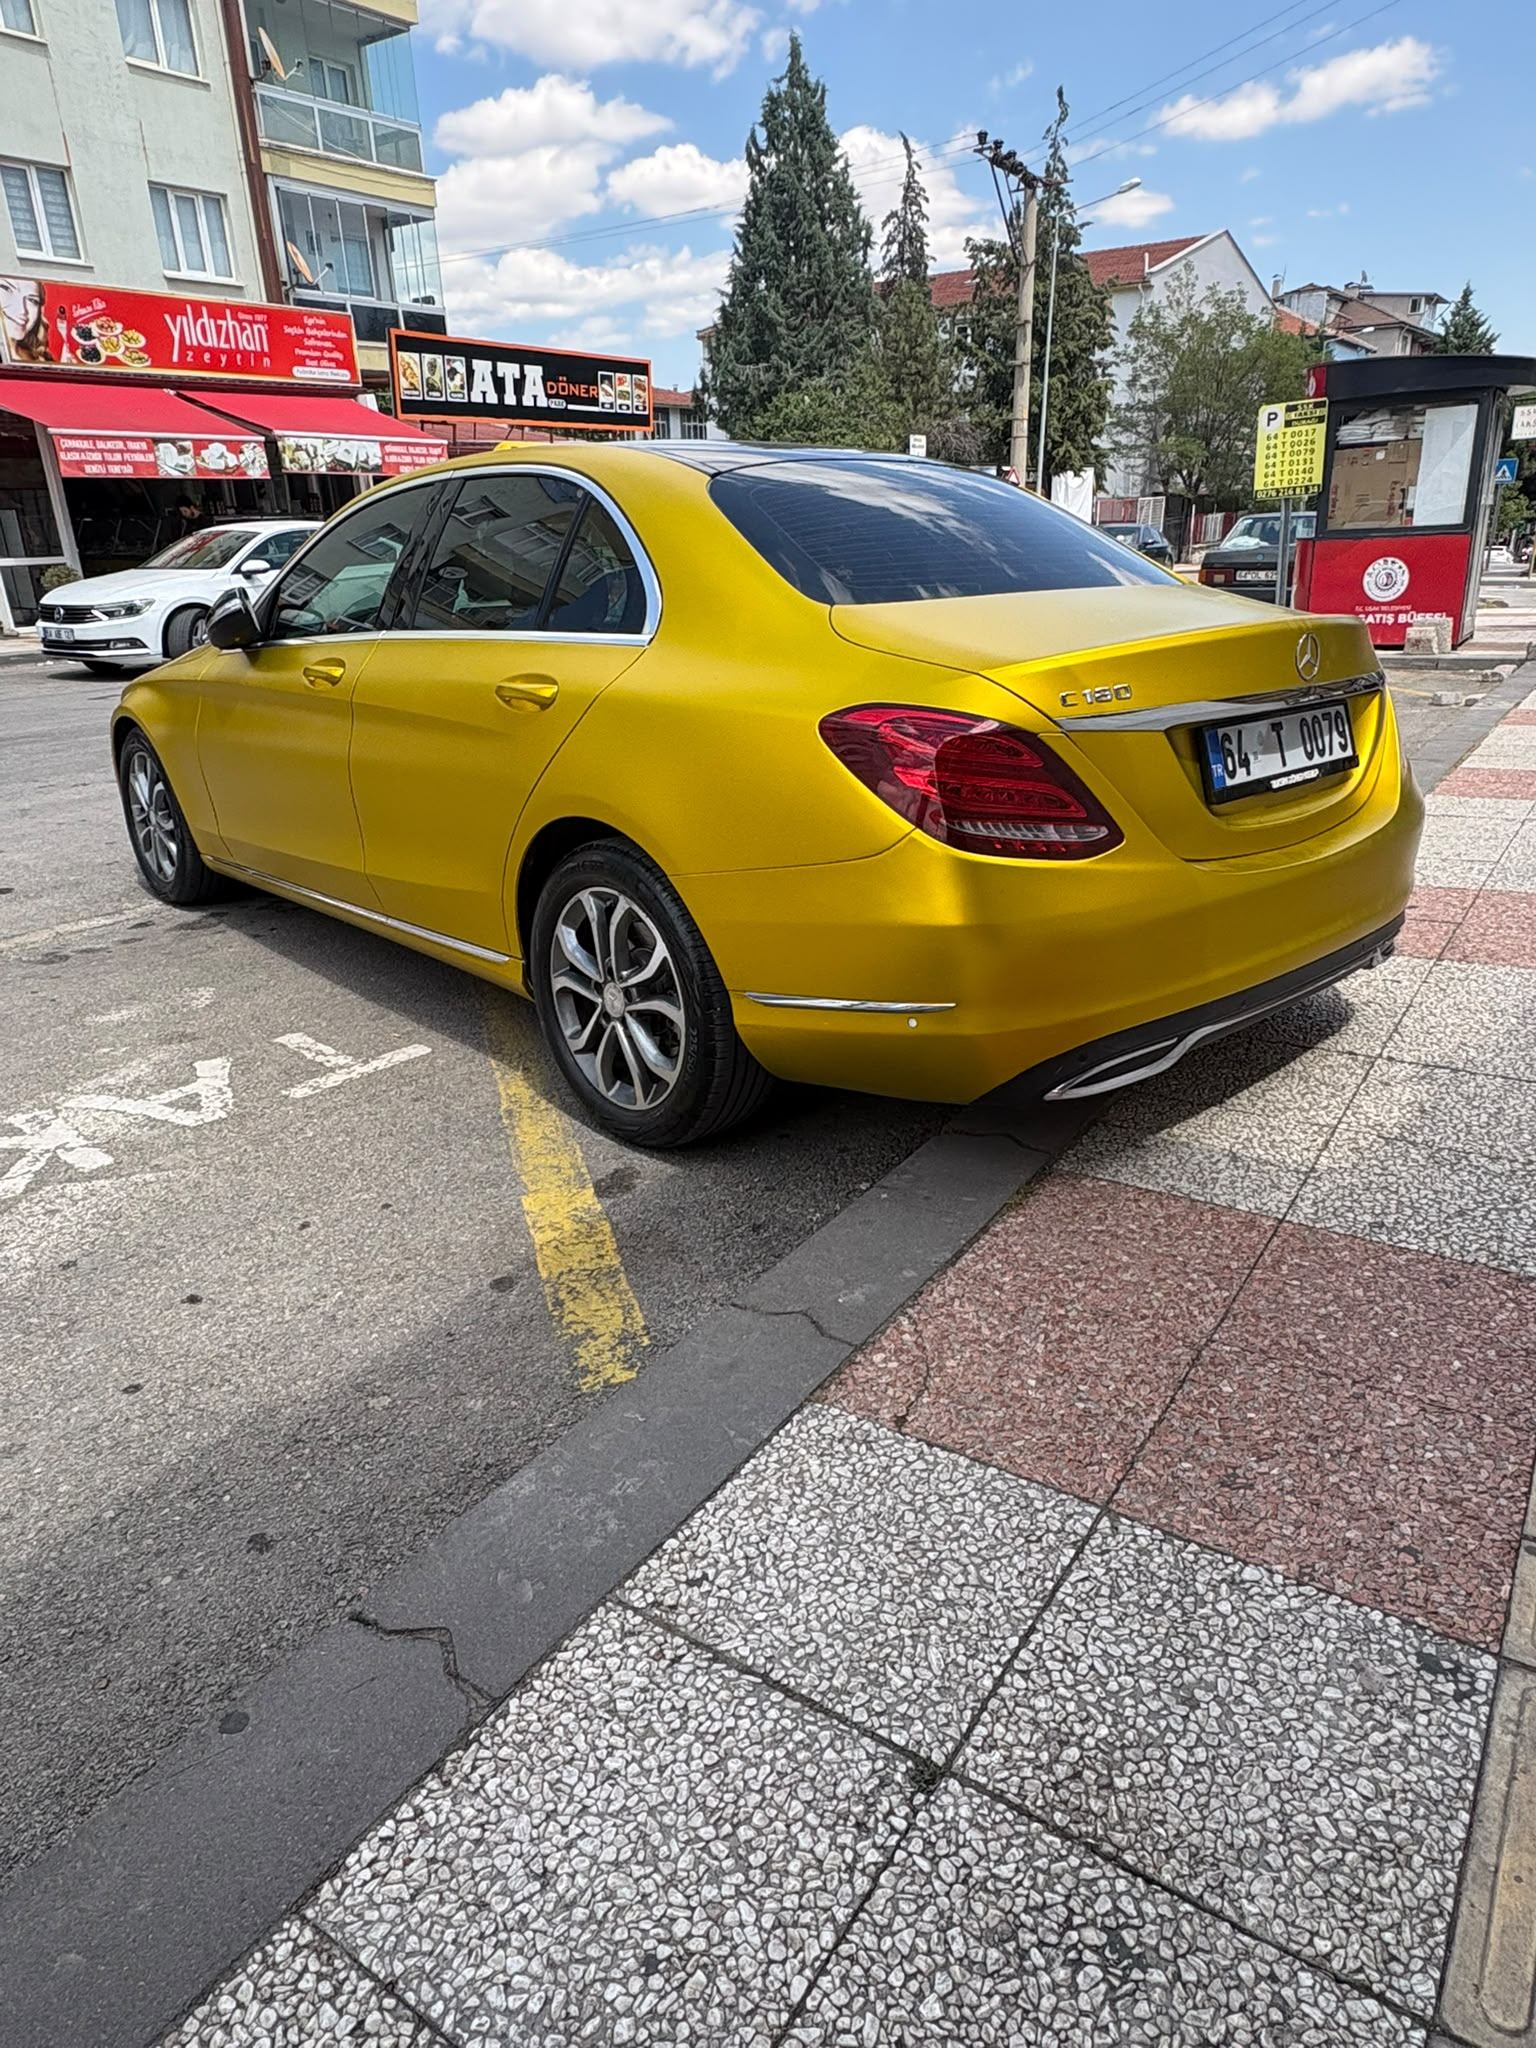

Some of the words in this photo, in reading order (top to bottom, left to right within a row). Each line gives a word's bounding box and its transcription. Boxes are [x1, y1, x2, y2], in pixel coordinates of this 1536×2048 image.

[163, 303, 269, 363] yıldızhan
[186, 350, 271, 368] zeytin
[470, 358, 548, 407] ATA
[546, 376, 599, 398] DÖNER
[1266, 412, 1278, 427] P
[1266, 432, 1278, 442] 64
[1290, 428, 1316, 438] 0017
[1266, 442, 1278, 451] 64
[1281, 441, 1287, 449] T
[1290, 438, 1316, 448] 0026
[1265, 452, 1277, 460] 64
[1280, 450, 1286, 458] T
[1289, 448, 1316, 458] 0079
[1264, 462, 1276, 470] 64
[1280, 460, 1286, 468] T
[1288, 458, 1314, 467] 0131
[1264, 470, 1276, 479] 64
[1288, 467, 1314, 476] 0140
[1263, 480, 1276, 488] 64
[1287, 477, 1313, 486] 0224
[1059, 690, 1078, 708] C
[1081, 684, 1132, 705] 180
[1211, 764, 1224, 778] TR
[1220, 729, 1252, 780] 64
[1271, 721, 1288, 768] T
[1300, 710, 1349, 762] 0079
